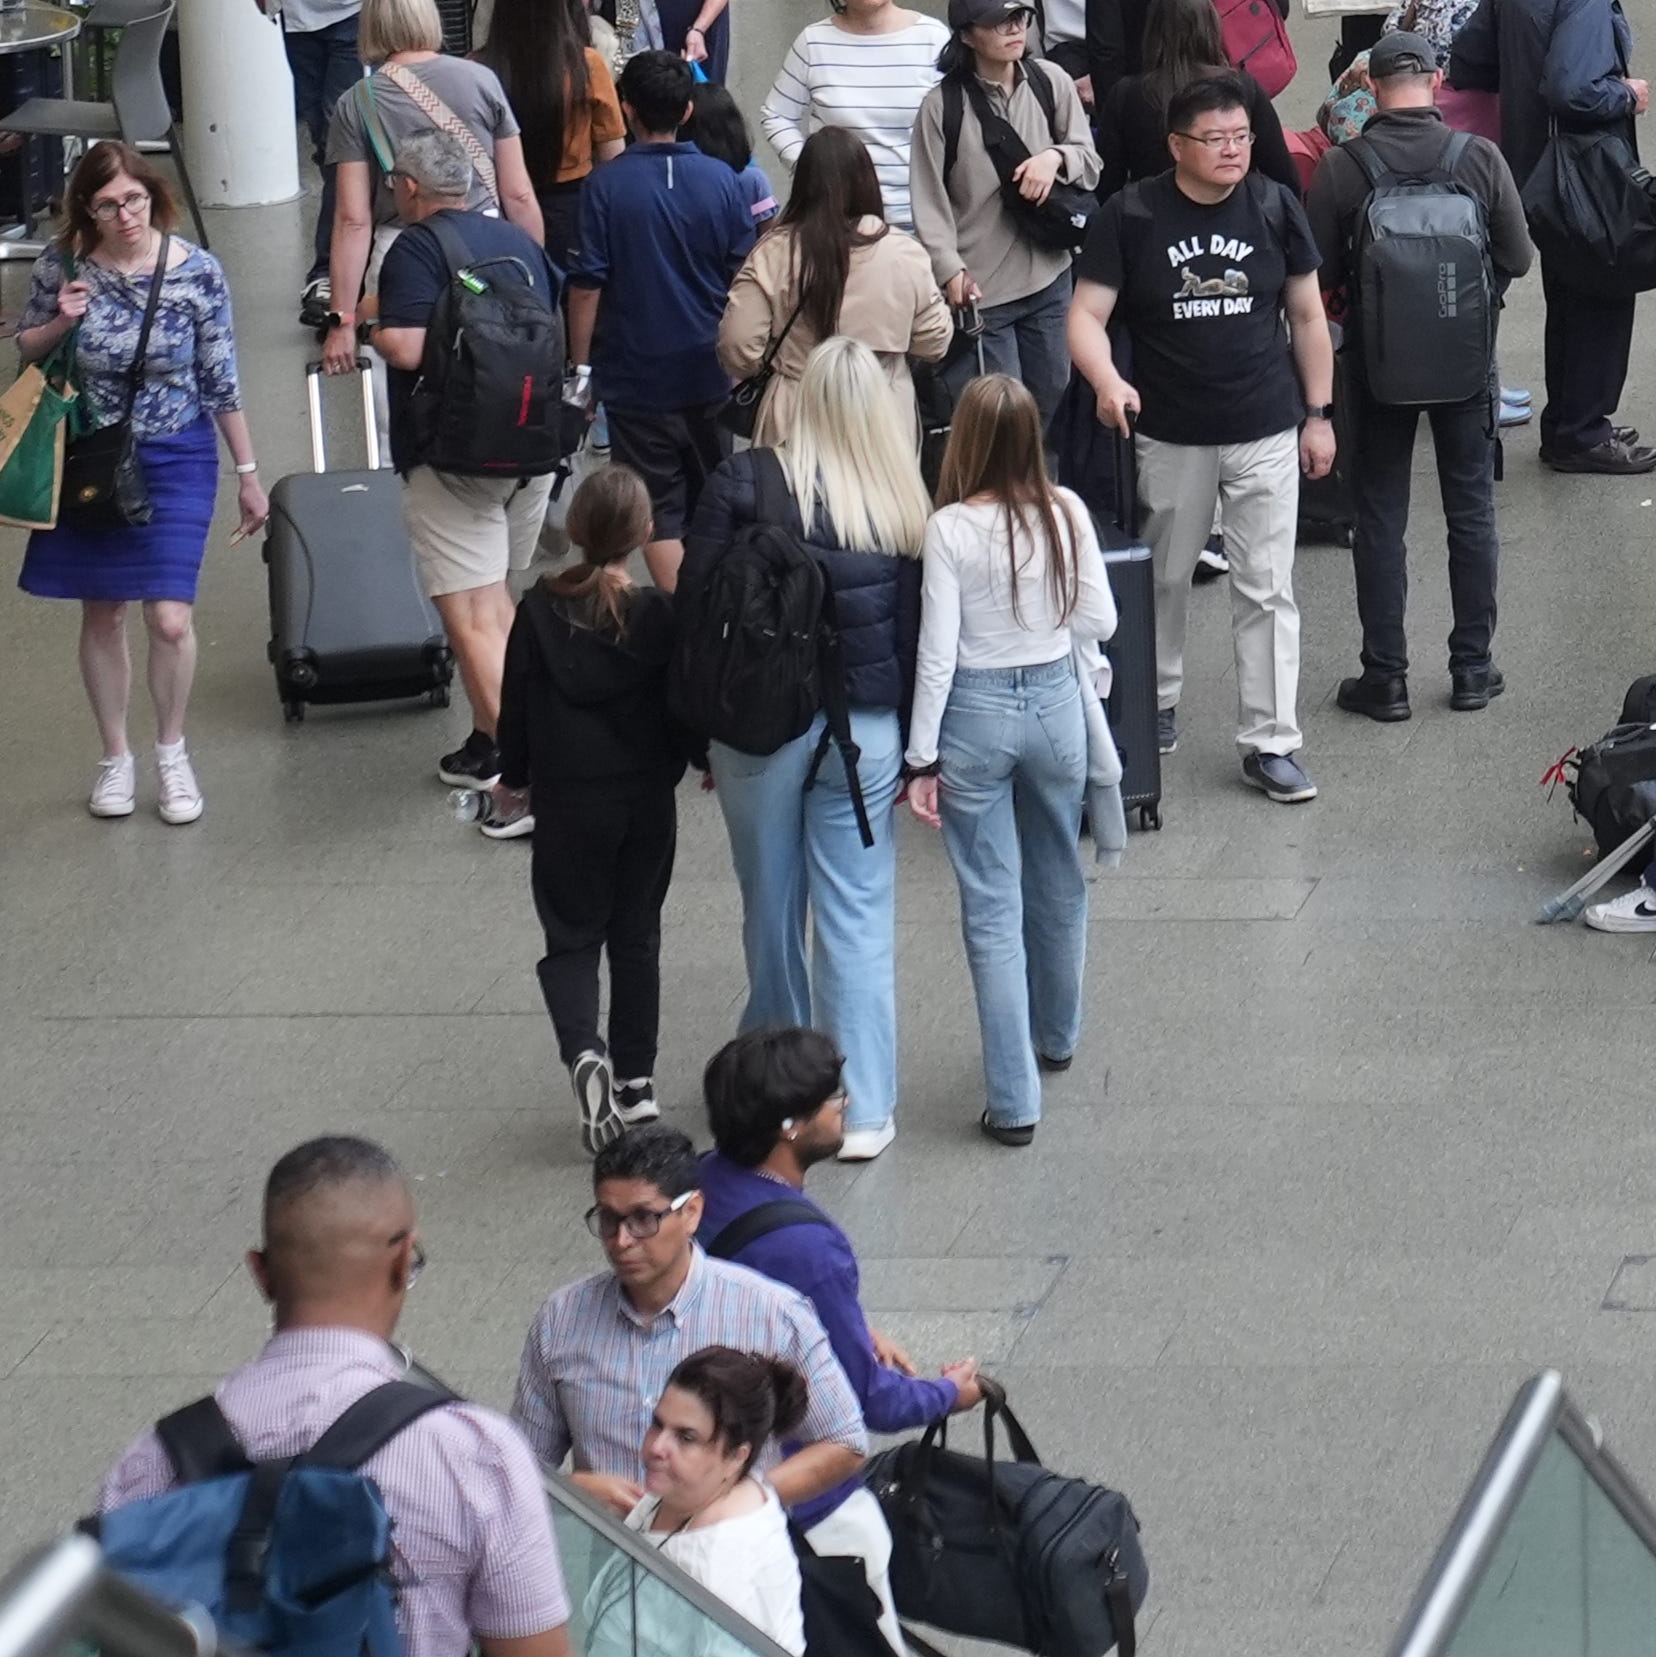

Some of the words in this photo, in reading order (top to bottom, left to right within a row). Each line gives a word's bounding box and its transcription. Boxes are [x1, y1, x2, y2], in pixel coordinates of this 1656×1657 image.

[1167, 235, 1205, 268] ALL
[1210, 233, 1255, 263] DAY
[1173, 298, 1222, 320] EVERY
[1223, 296, 1255, 316] DAY
[1437, 262, 1447, 319] GoPro
